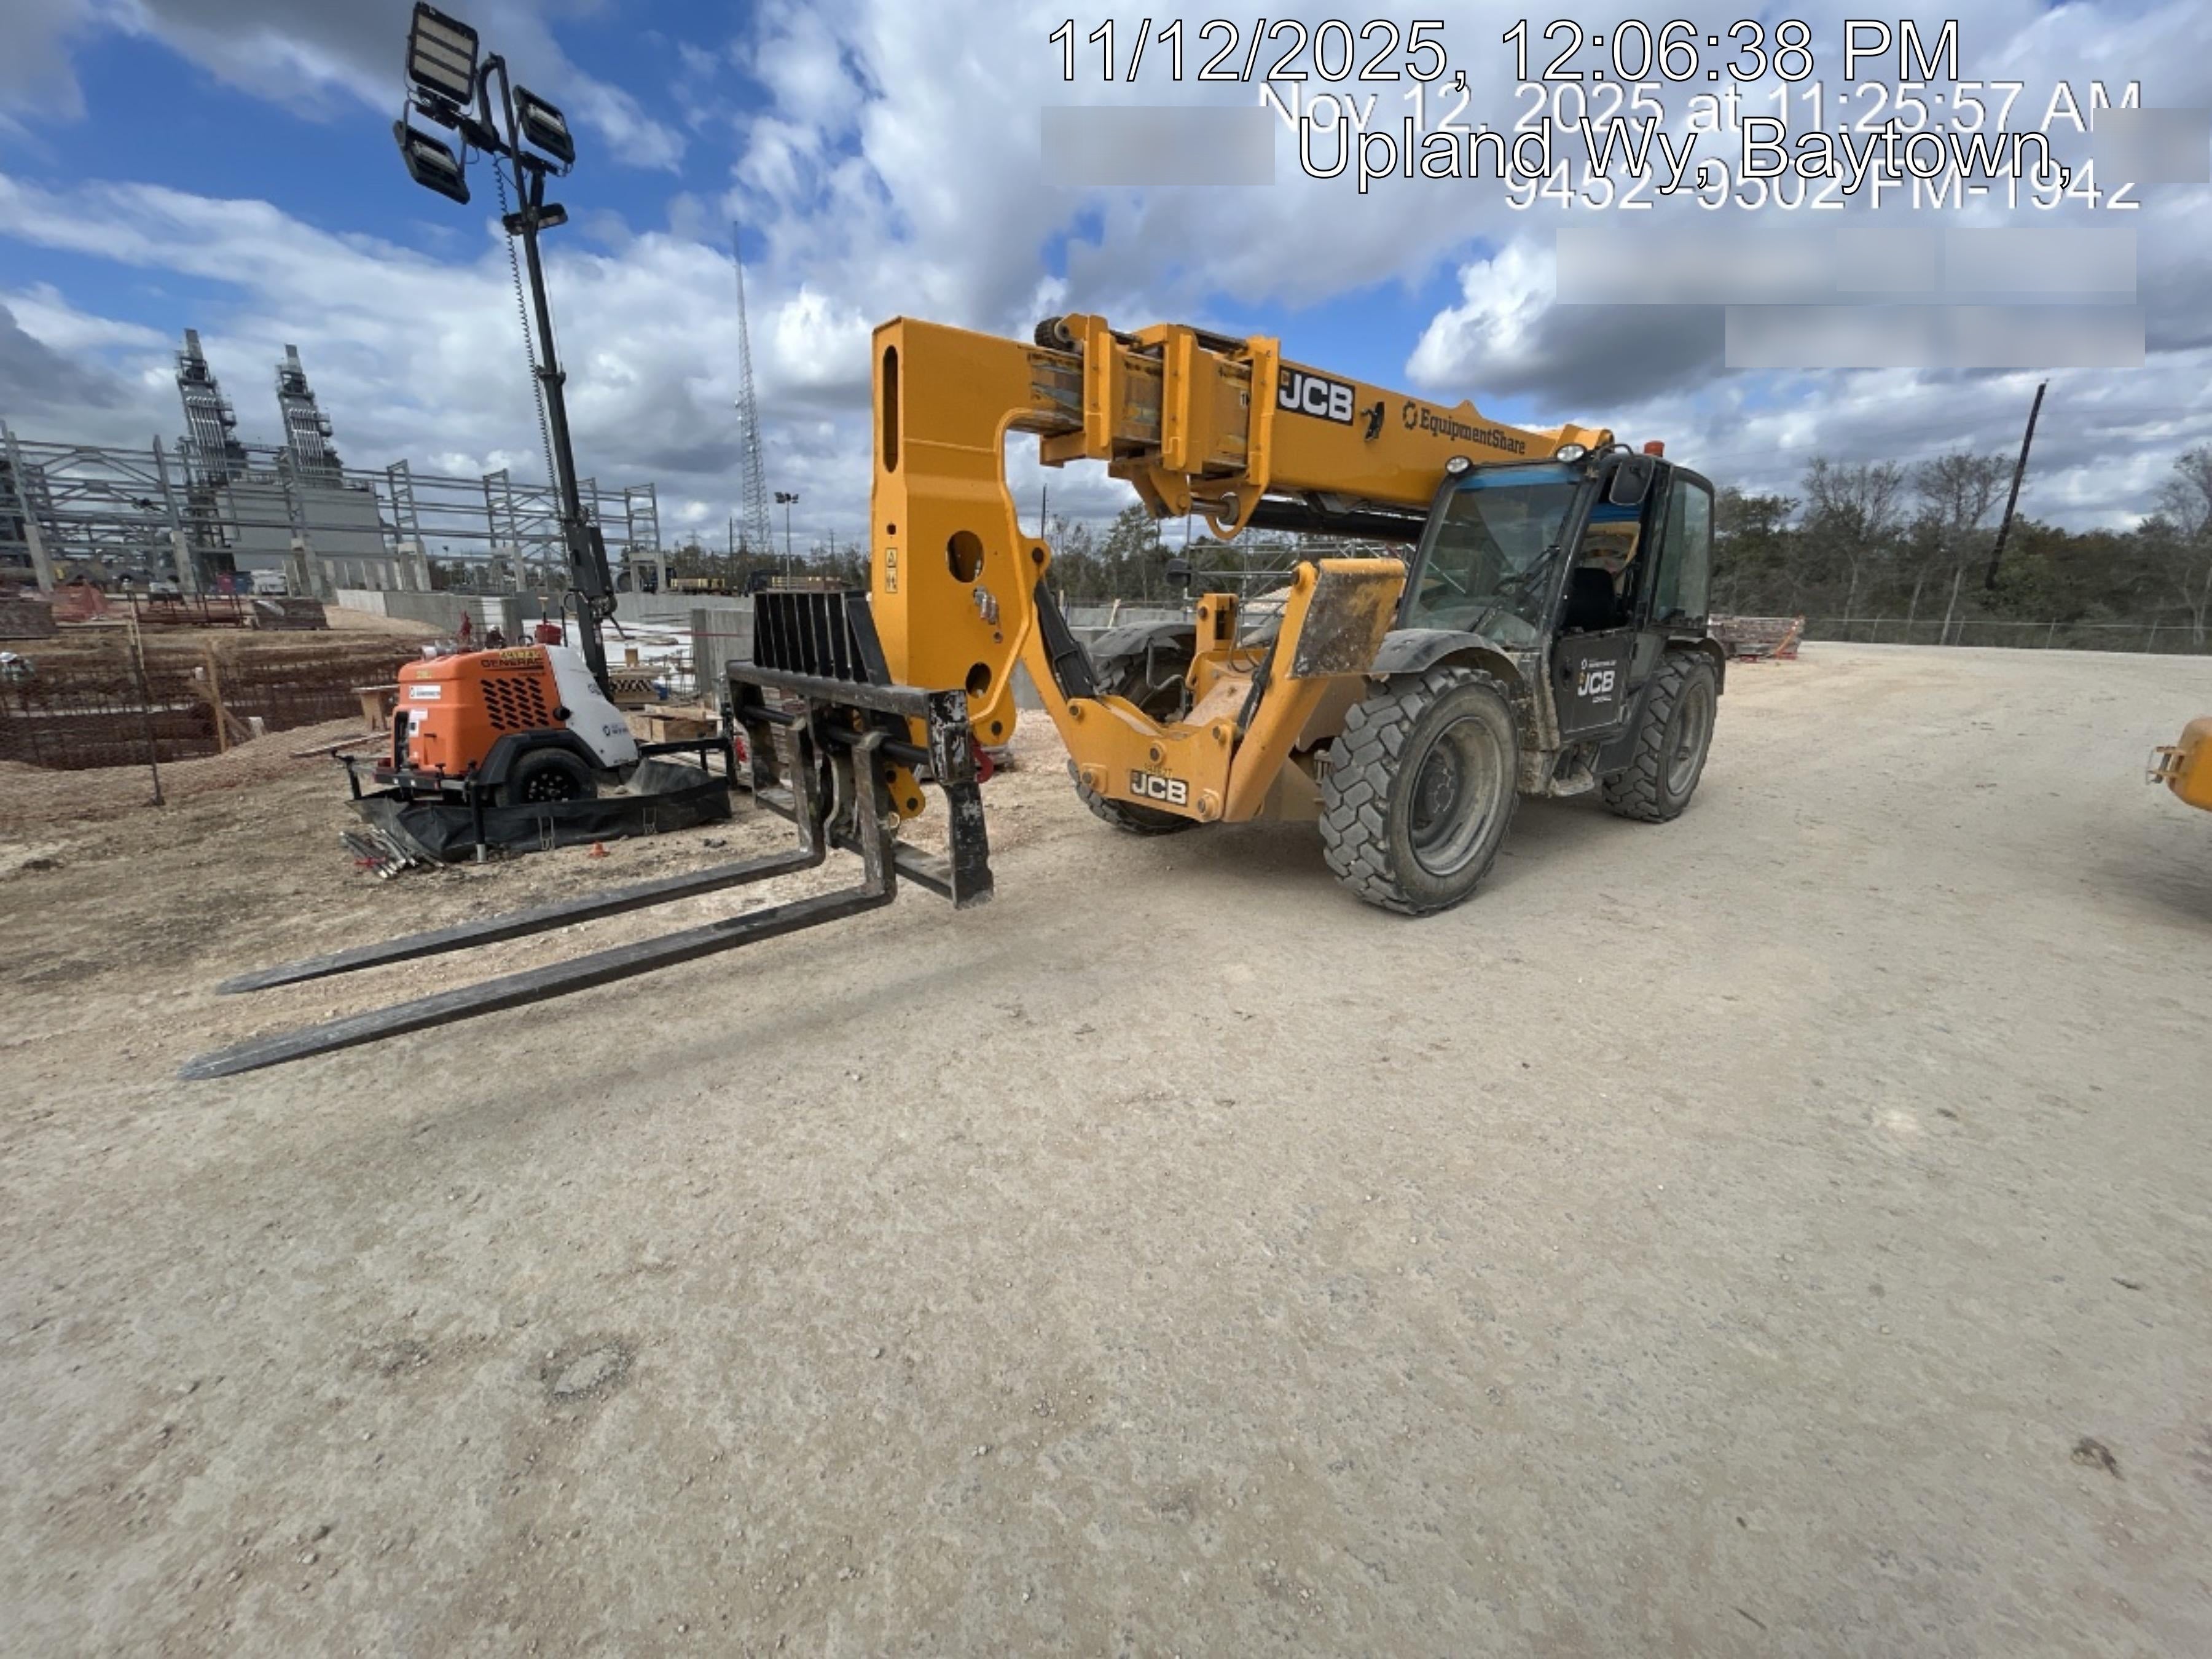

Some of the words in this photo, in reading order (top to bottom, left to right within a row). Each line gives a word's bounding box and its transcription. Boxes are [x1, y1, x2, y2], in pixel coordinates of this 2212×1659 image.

[1279, 373, 1352, 421] JCB
[1419, 407, 1526, 455] EquipmentShare
[481, 658, 544, 668] GENERAC
[1577, 670, 1615, 696] JCB
[1131, 773, 1186, 805] JCB
